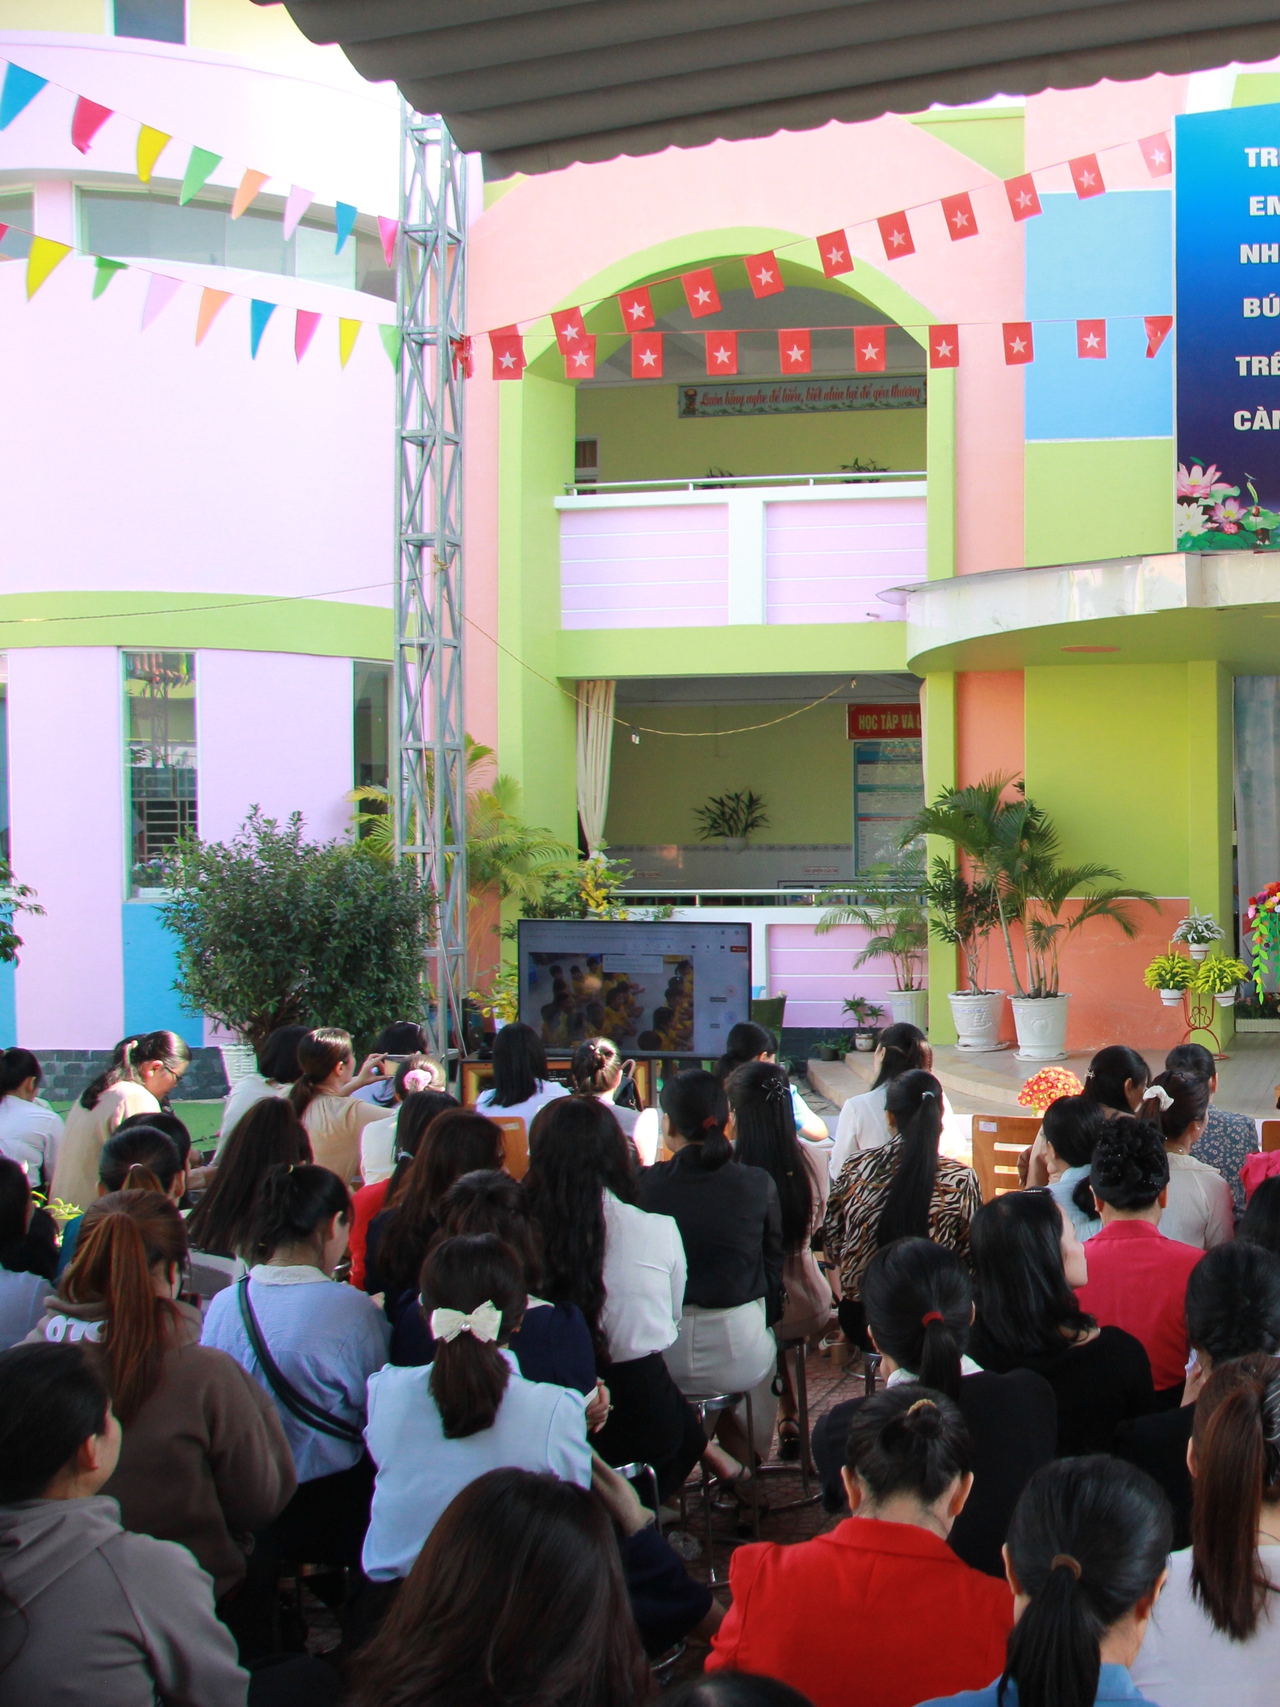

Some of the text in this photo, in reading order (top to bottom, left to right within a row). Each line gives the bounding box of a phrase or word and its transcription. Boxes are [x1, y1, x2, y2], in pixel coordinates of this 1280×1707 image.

[859, 715, 878, 733] HỌC
[881, 712, 898, 733] TẬP
[902, 711, 914, 729] VÀ
